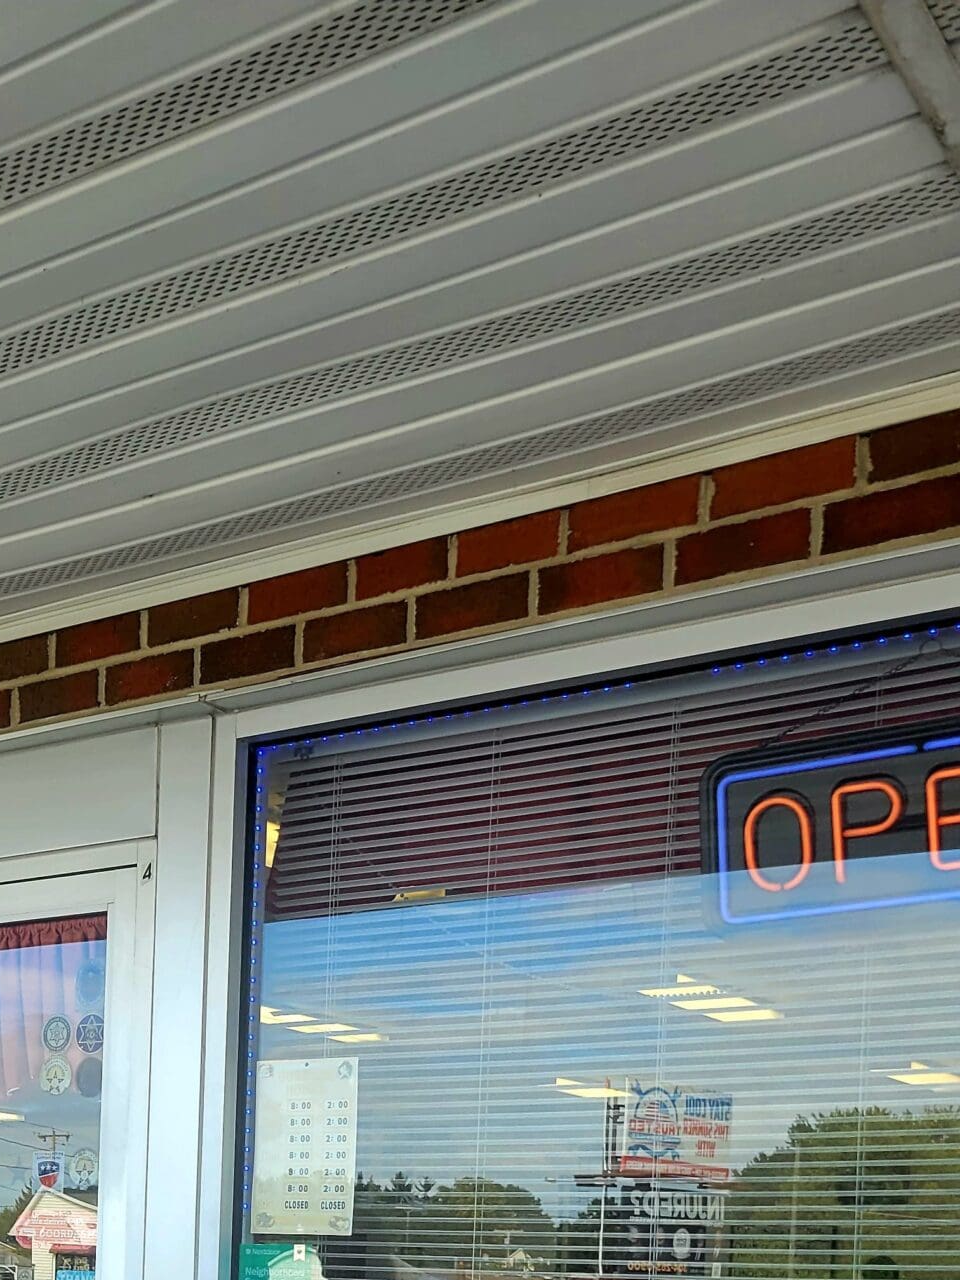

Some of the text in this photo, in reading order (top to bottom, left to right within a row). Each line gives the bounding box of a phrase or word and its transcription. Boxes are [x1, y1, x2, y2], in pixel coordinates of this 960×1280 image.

[142, 862, 152, 880] 4
[284, 1200, 346, 1210] CLOSED CLOSED
